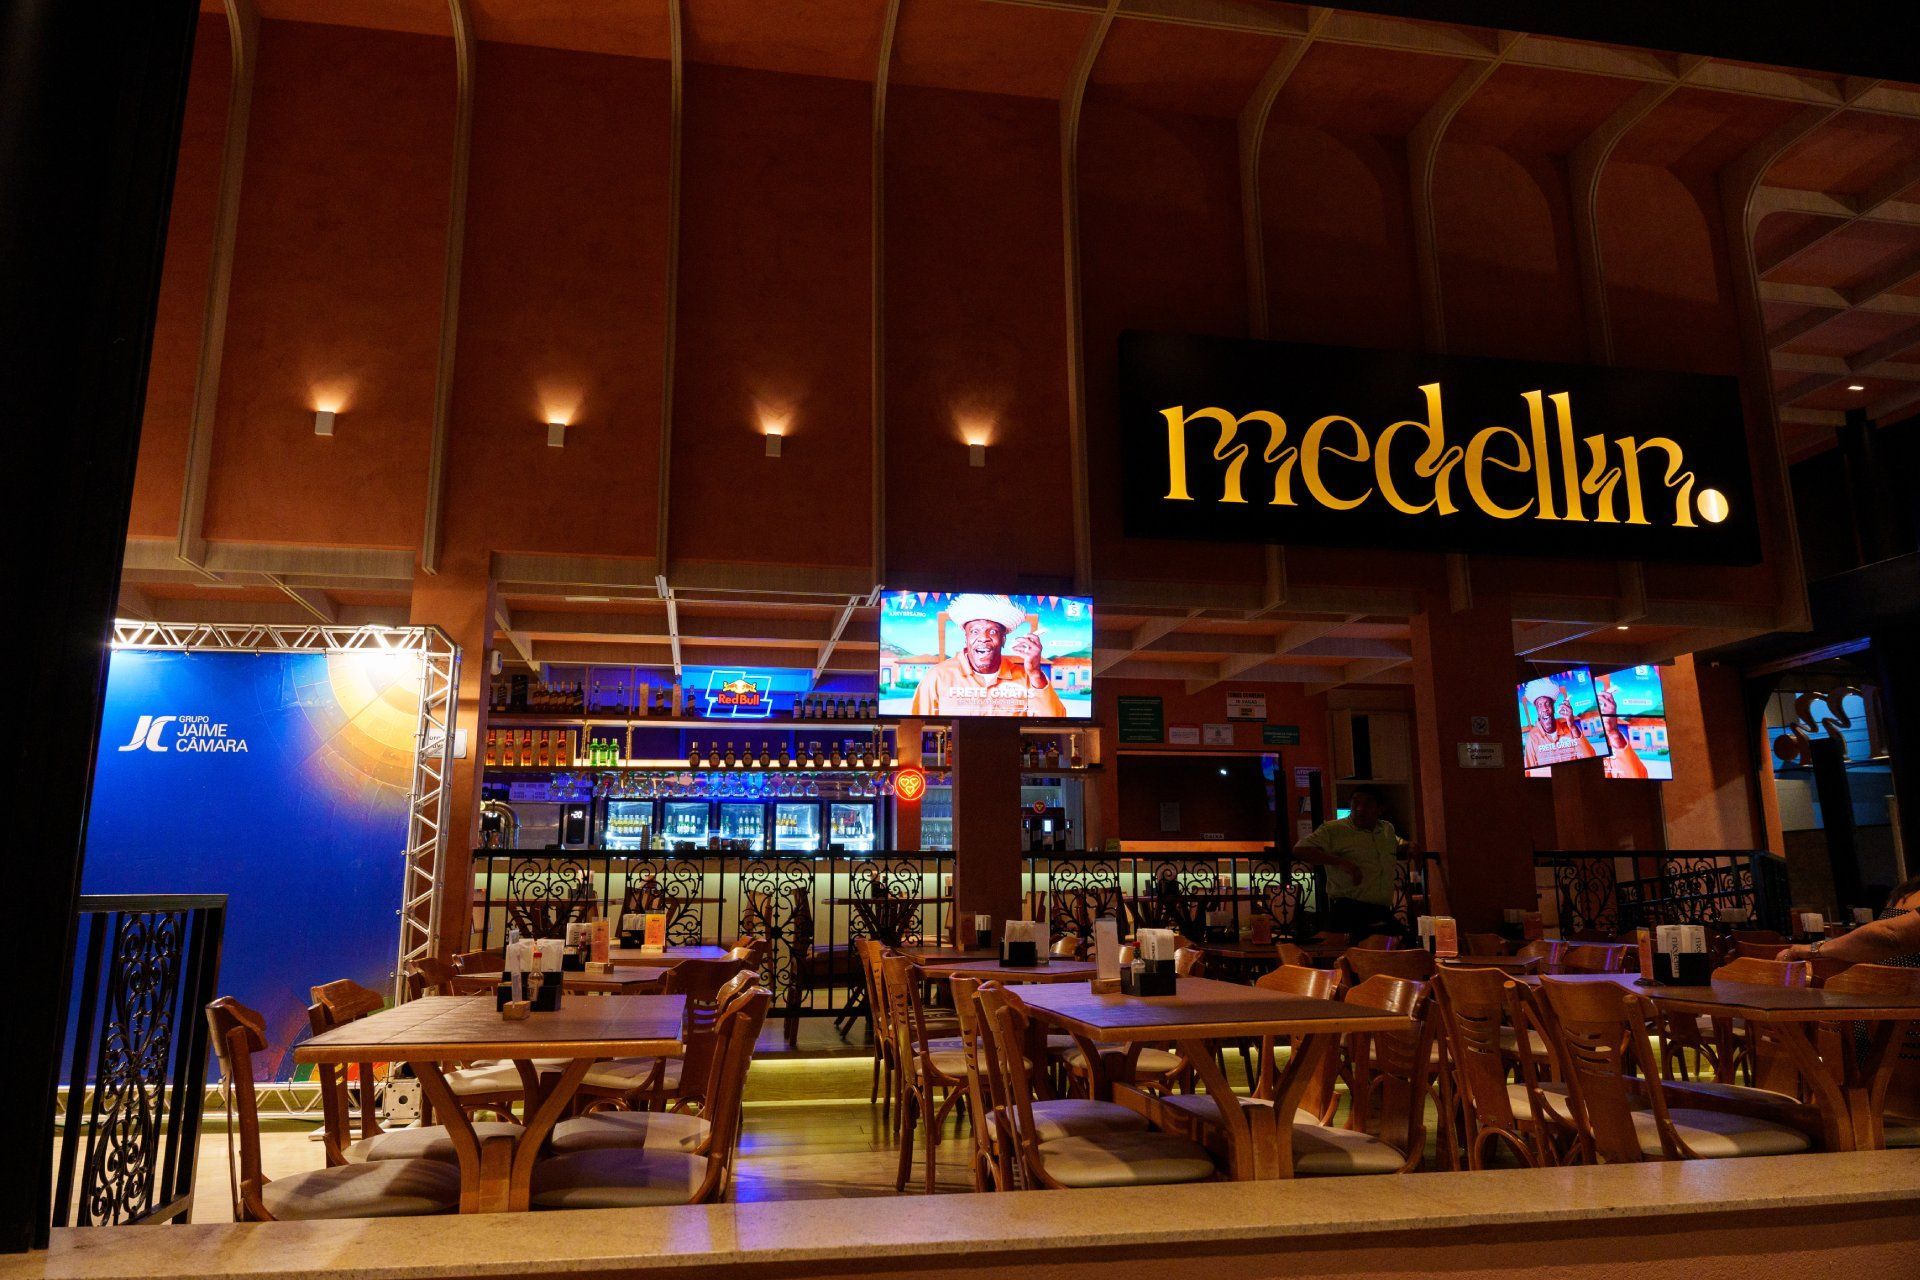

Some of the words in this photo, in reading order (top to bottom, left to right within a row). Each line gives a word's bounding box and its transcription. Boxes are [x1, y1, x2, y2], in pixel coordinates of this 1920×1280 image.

[718, 693, 739, 704] Red
[739, 694, 760, 705] Bull
[949, 686, 988, 699] FRETE
[178, 715, 210, 723] GRUPO
[118, 715, 177, 752] JC
[176, 723, 228, 737] JAIME
[175, 737, 249, 753] CÂMARA
